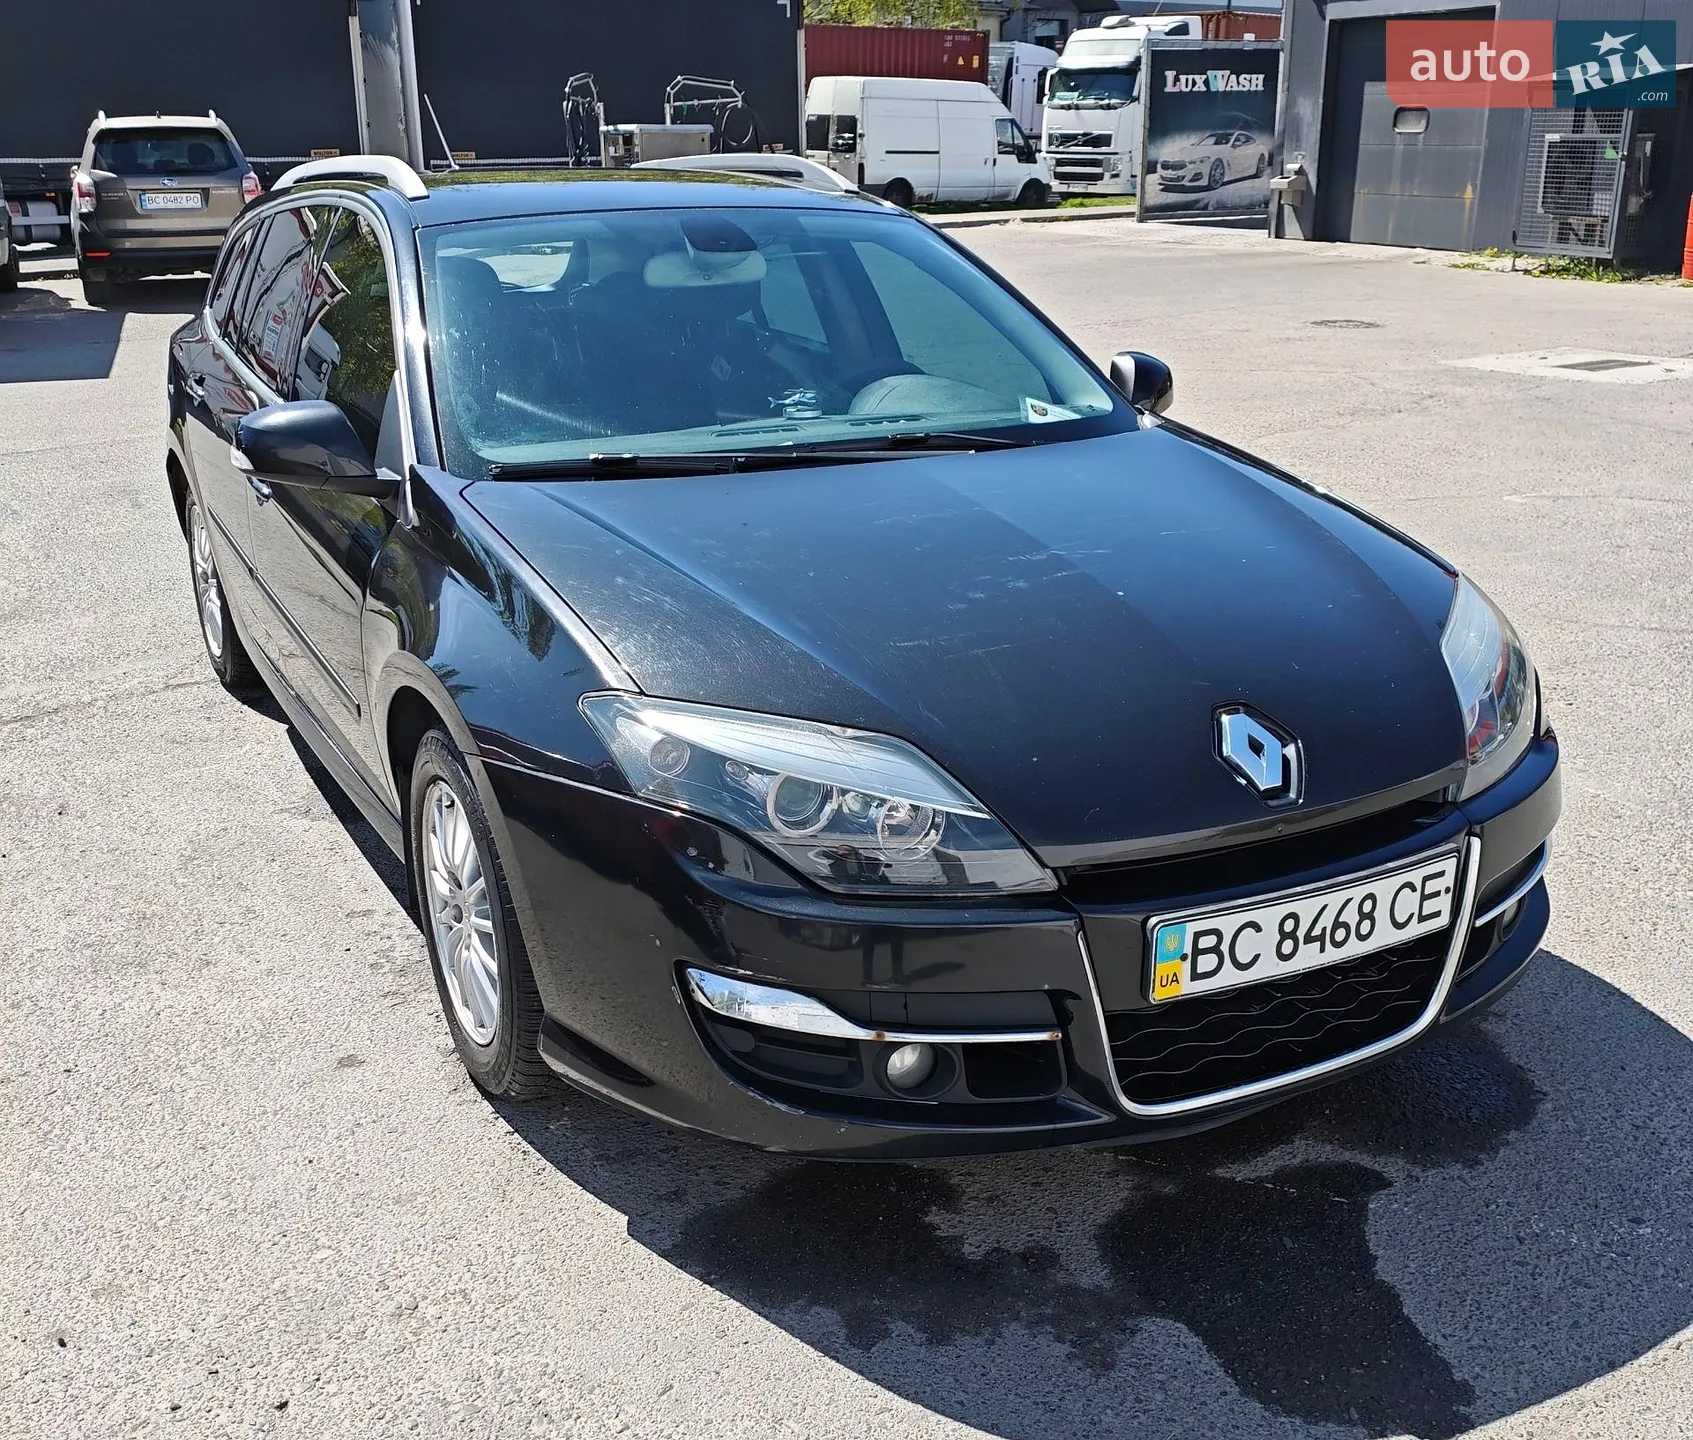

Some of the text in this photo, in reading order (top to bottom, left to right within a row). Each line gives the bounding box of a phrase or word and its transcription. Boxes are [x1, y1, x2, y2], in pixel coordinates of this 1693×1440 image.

[147, 195, 199, 205] BC 0482 PO
[1189, 869, 1447, 982] BC 8468 CE
[1159, 971, 1180, 988] UA
